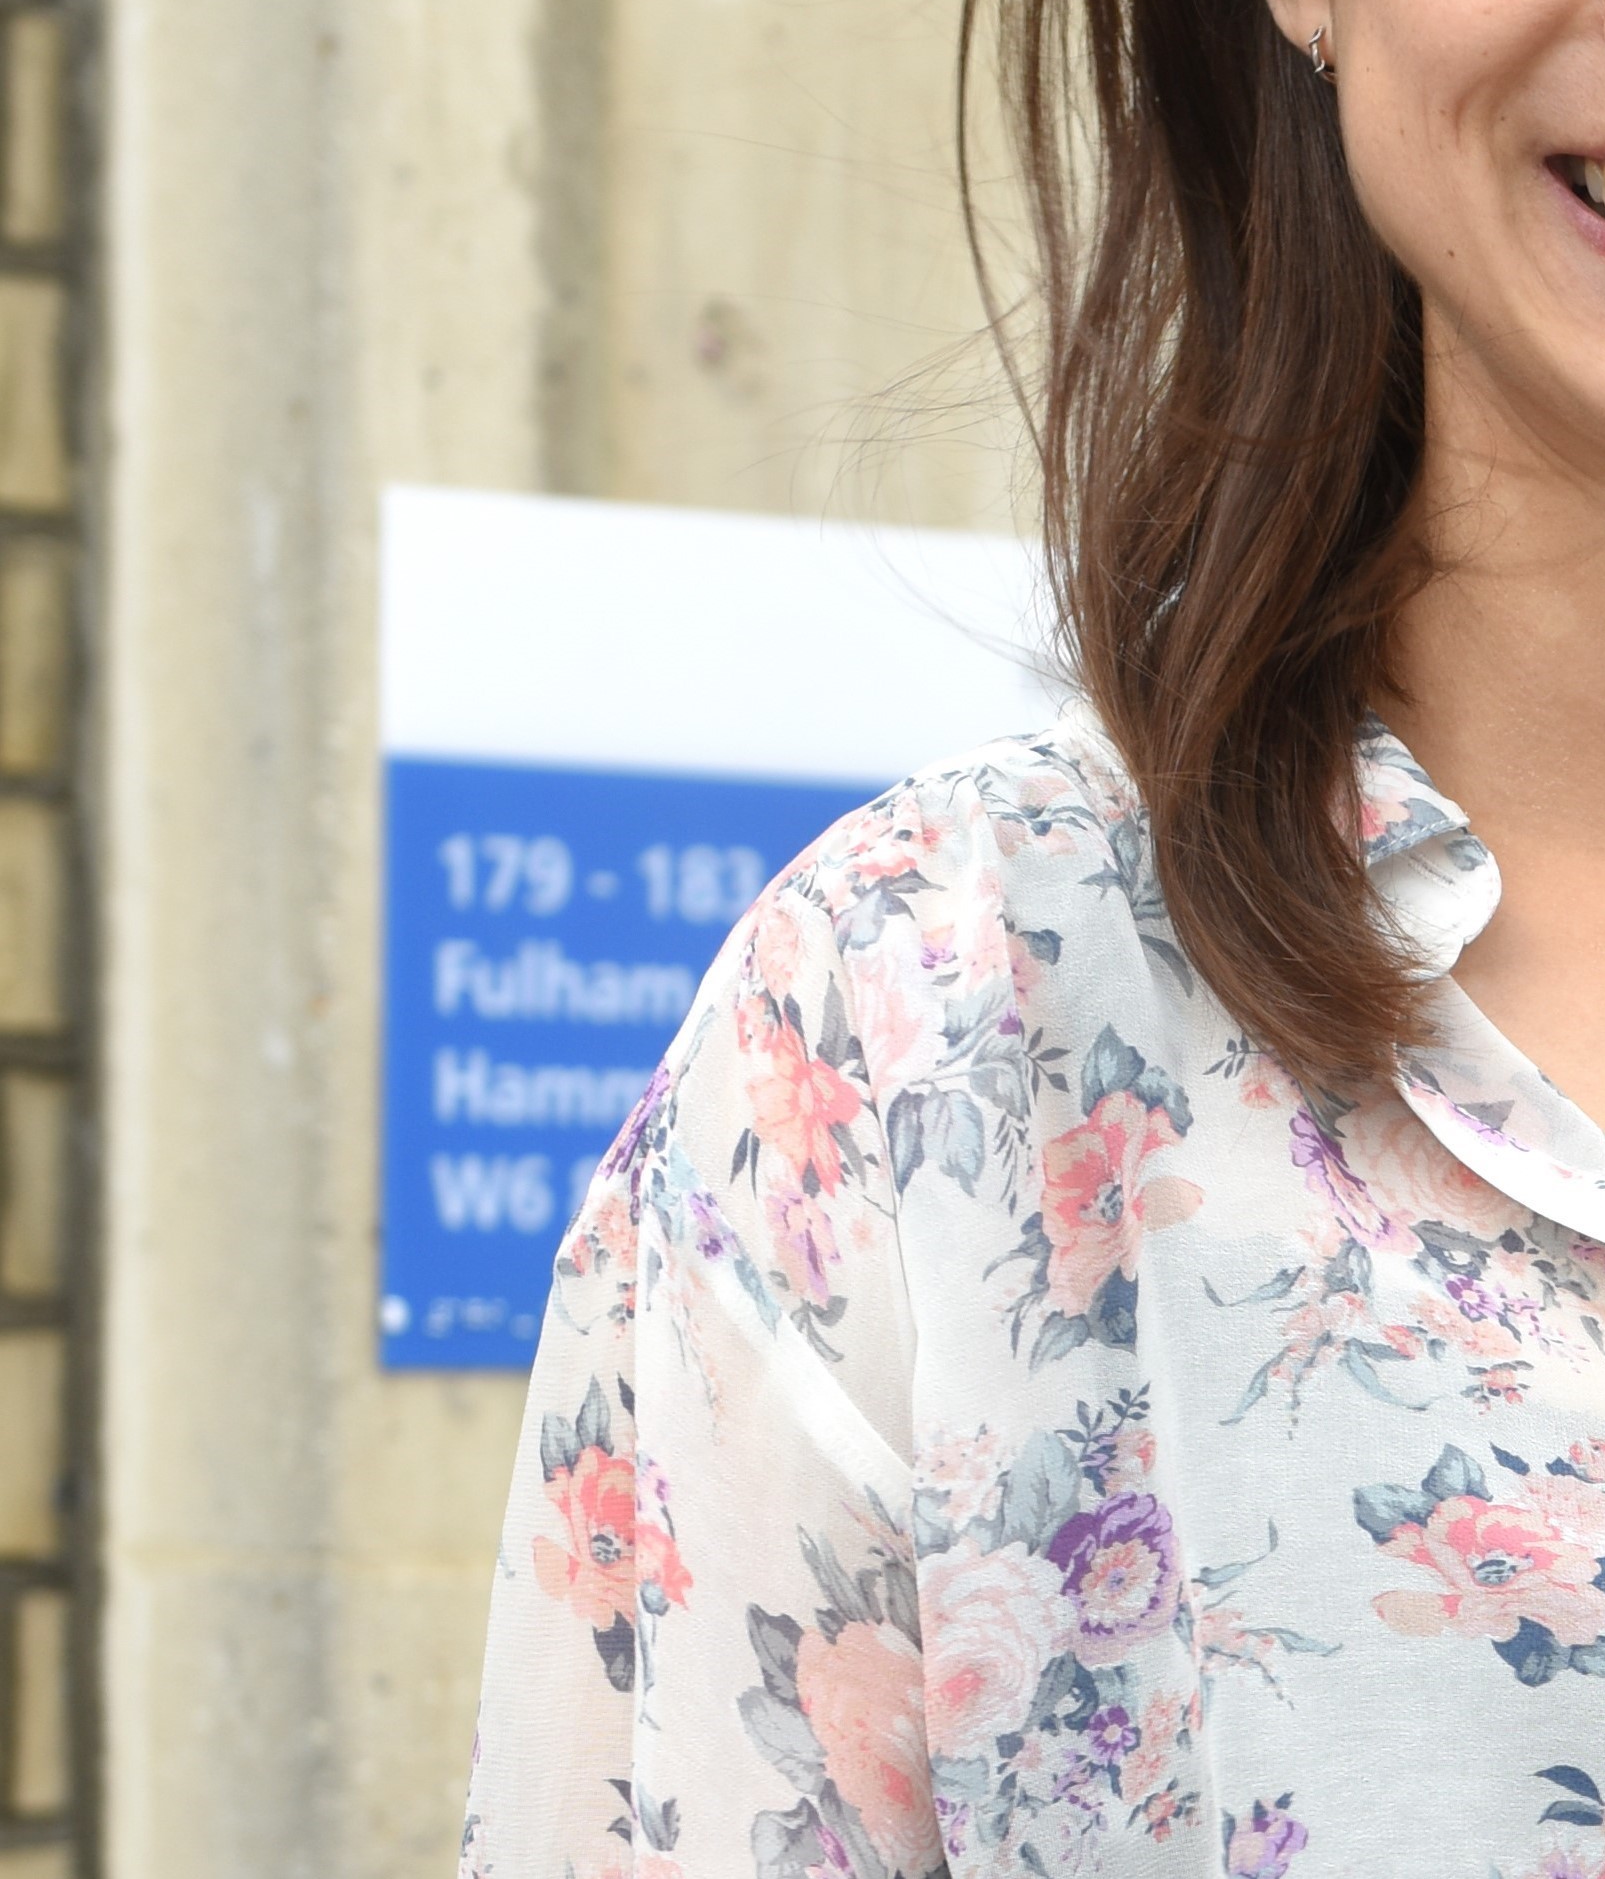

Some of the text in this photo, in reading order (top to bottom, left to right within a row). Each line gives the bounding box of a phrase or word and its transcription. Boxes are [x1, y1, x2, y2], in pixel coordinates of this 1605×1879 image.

[439, 833, 572, 916] 179
[640, 845, 766, 922] 183
[434, 939, 697, 1023] Fulham
[431, 1154, 554, 1233] W6
